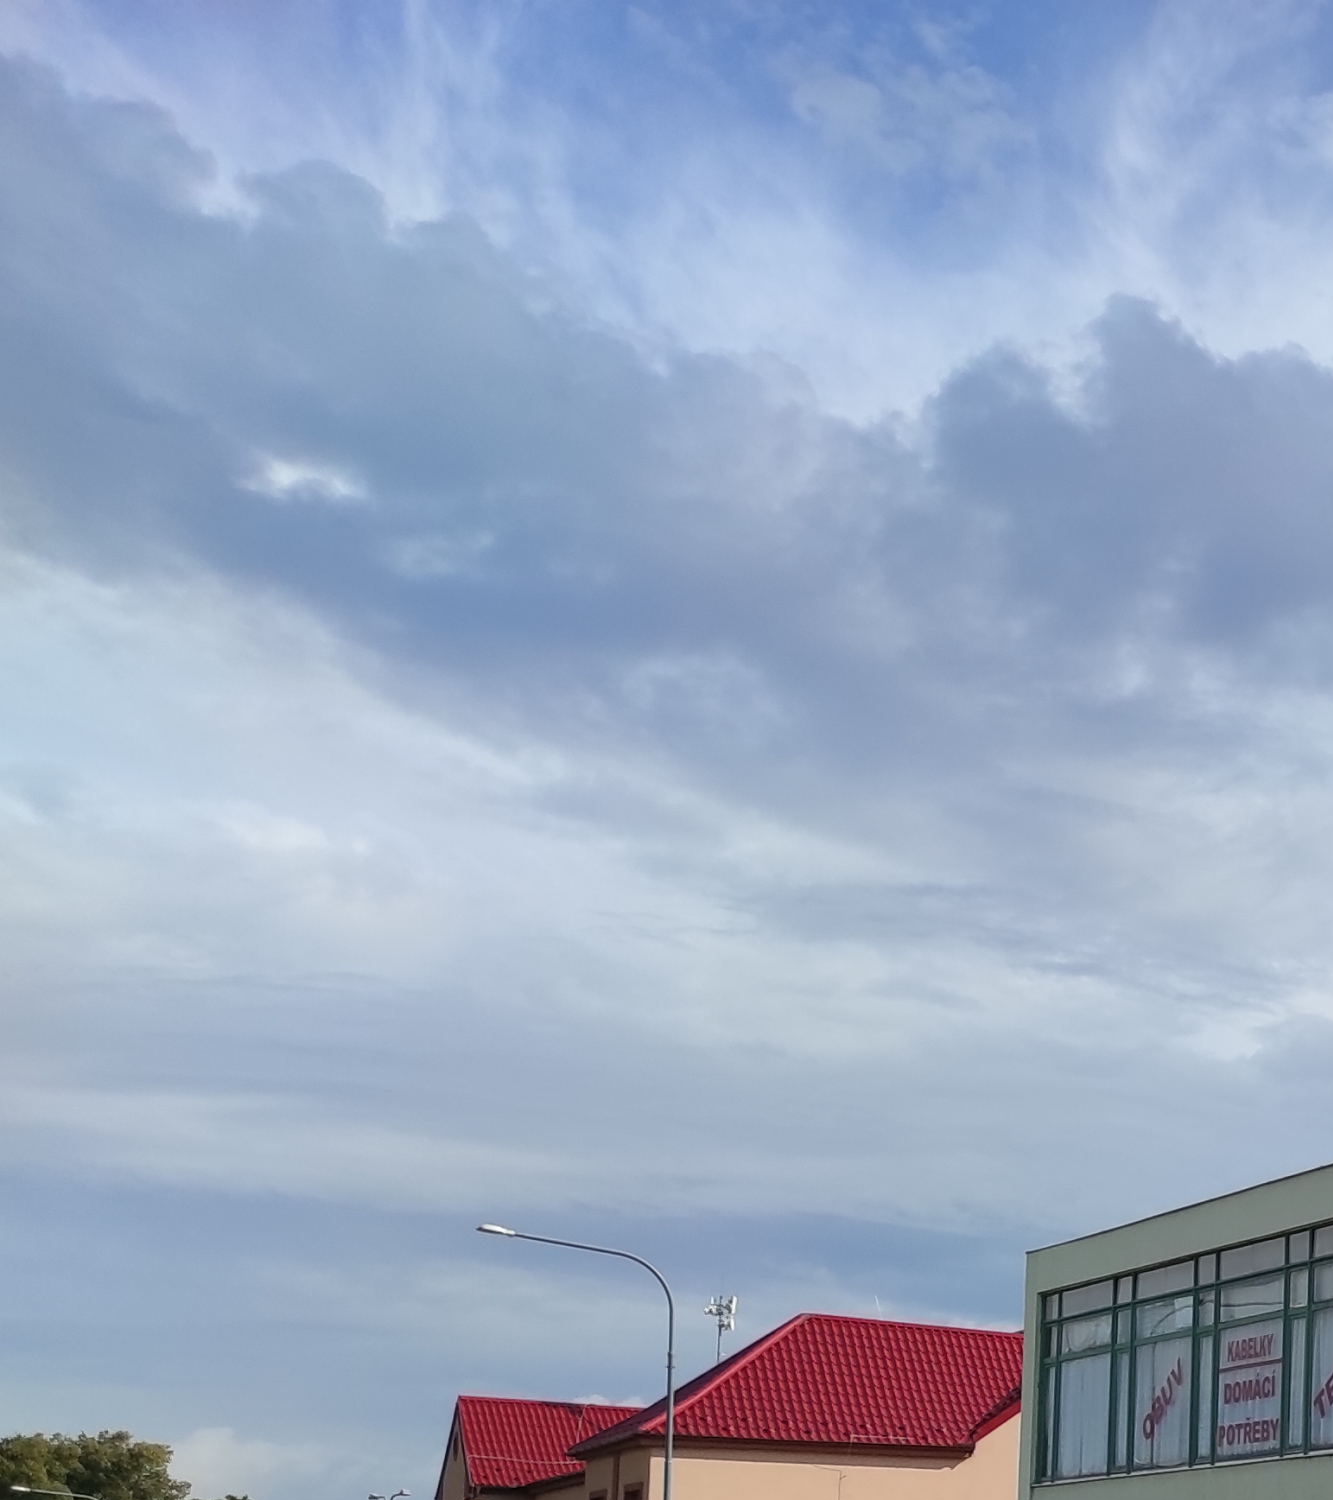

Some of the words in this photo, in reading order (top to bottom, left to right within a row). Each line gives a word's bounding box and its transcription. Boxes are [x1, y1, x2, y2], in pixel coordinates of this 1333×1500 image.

[1227, 1334, 1274, 1362] KABELKY
[1142, 1357, 1184, 1441] OBUV
[1224, 1370, 1276, 1405] DOMÁCÍ
[1218, 1418, 1279, 1447] POTŘEBY
